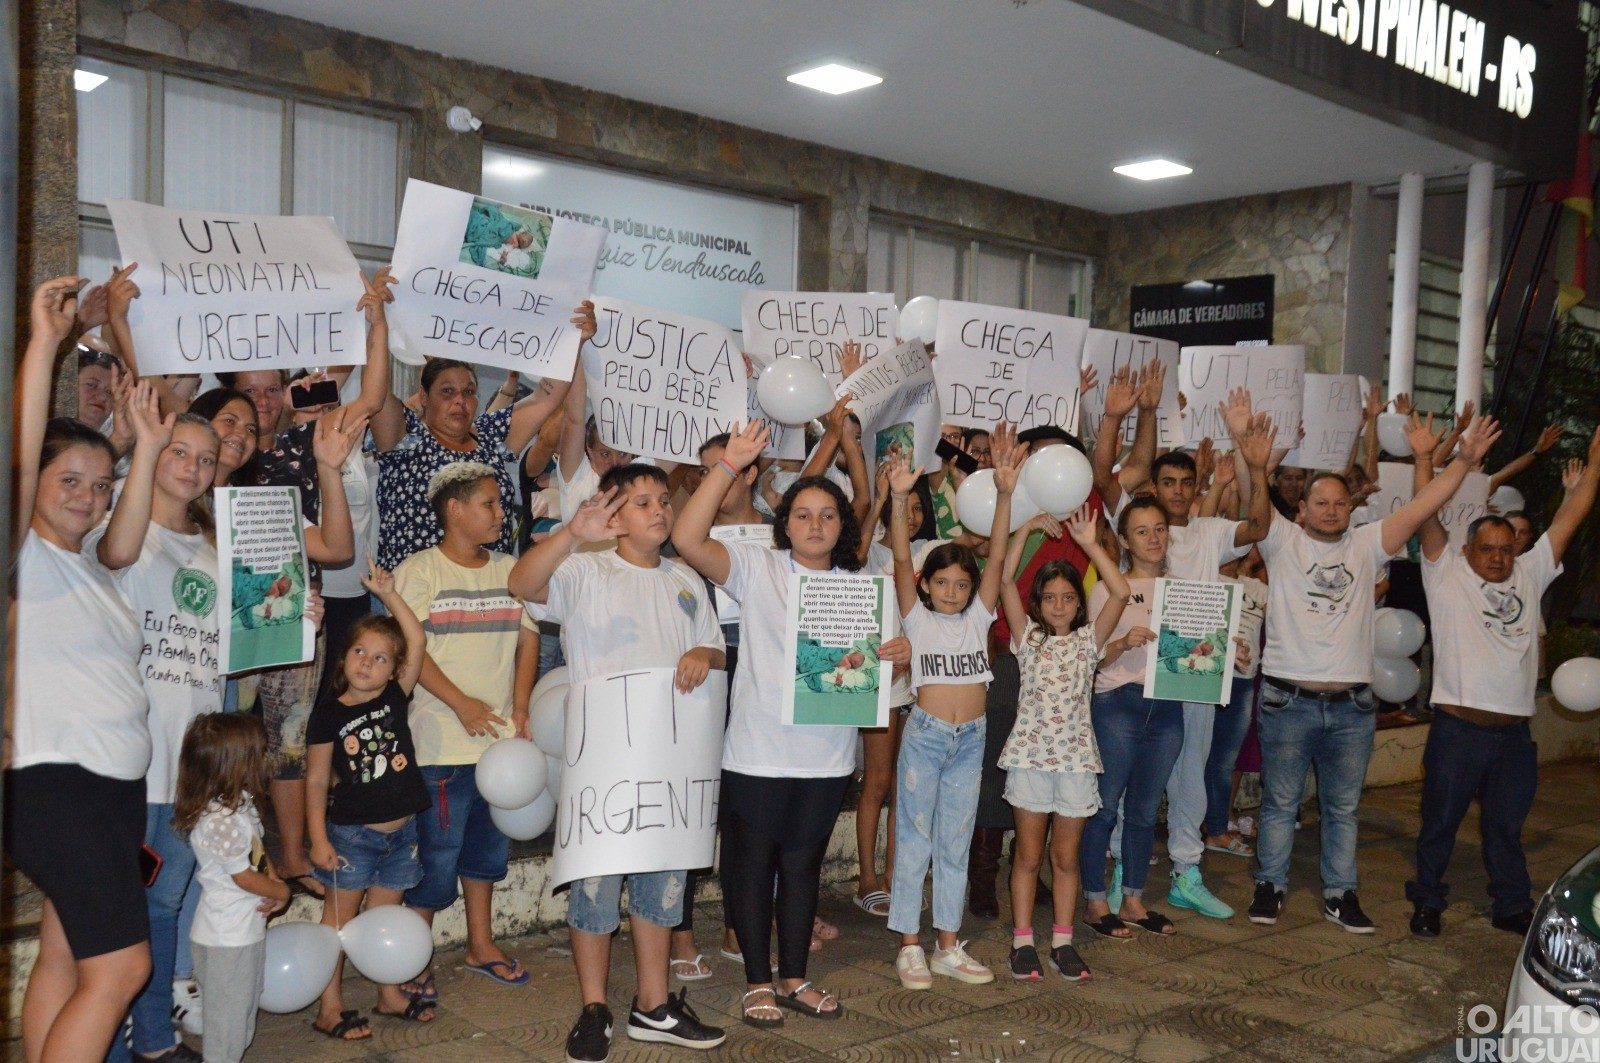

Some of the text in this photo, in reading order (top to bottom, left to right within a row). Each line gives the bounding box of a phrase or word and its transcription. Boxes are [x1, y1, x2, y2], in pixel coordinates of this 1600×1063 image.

[1286, 0, 1485, 97] ESTPHALEN
[1498, 35, 1536, 119] RS
[178, 217, 267, 255] UTI
[613, 217, 675, 244] PÚBLICA
[677, 230, 751, 256] MUNICIPAL
[160, 260, 331, 296] NEONATAL
[596, 243, 766, 286] uiz Vendruscolo
[411, 265, 553, 318] CHEGA DE
[177, 310, 345, 362] URGENTE
[757, 299, 889, 339] CHEGA DE
[1133, 301, 1266, 328] CÂMARA DE VEREADORES
[423, 313, 560, 365] DESCASO!!
[589, 307, 735, 383] JUSTIÇA
[961, 318, 1055, 361] CHEGA
[604, 360, 652, 393] PELO
[664, 372, 722, 412] BEBÊ
[985, 361, 1015, 380] DE
[1190, 352, 1251, 391] UTI
[946, 383, 1080, 433] DESCASO!
[144, 610, 163, 632] Eu
[564, 669, 677, 768] UTI
[559, 776, 721, 849] URGENTE
